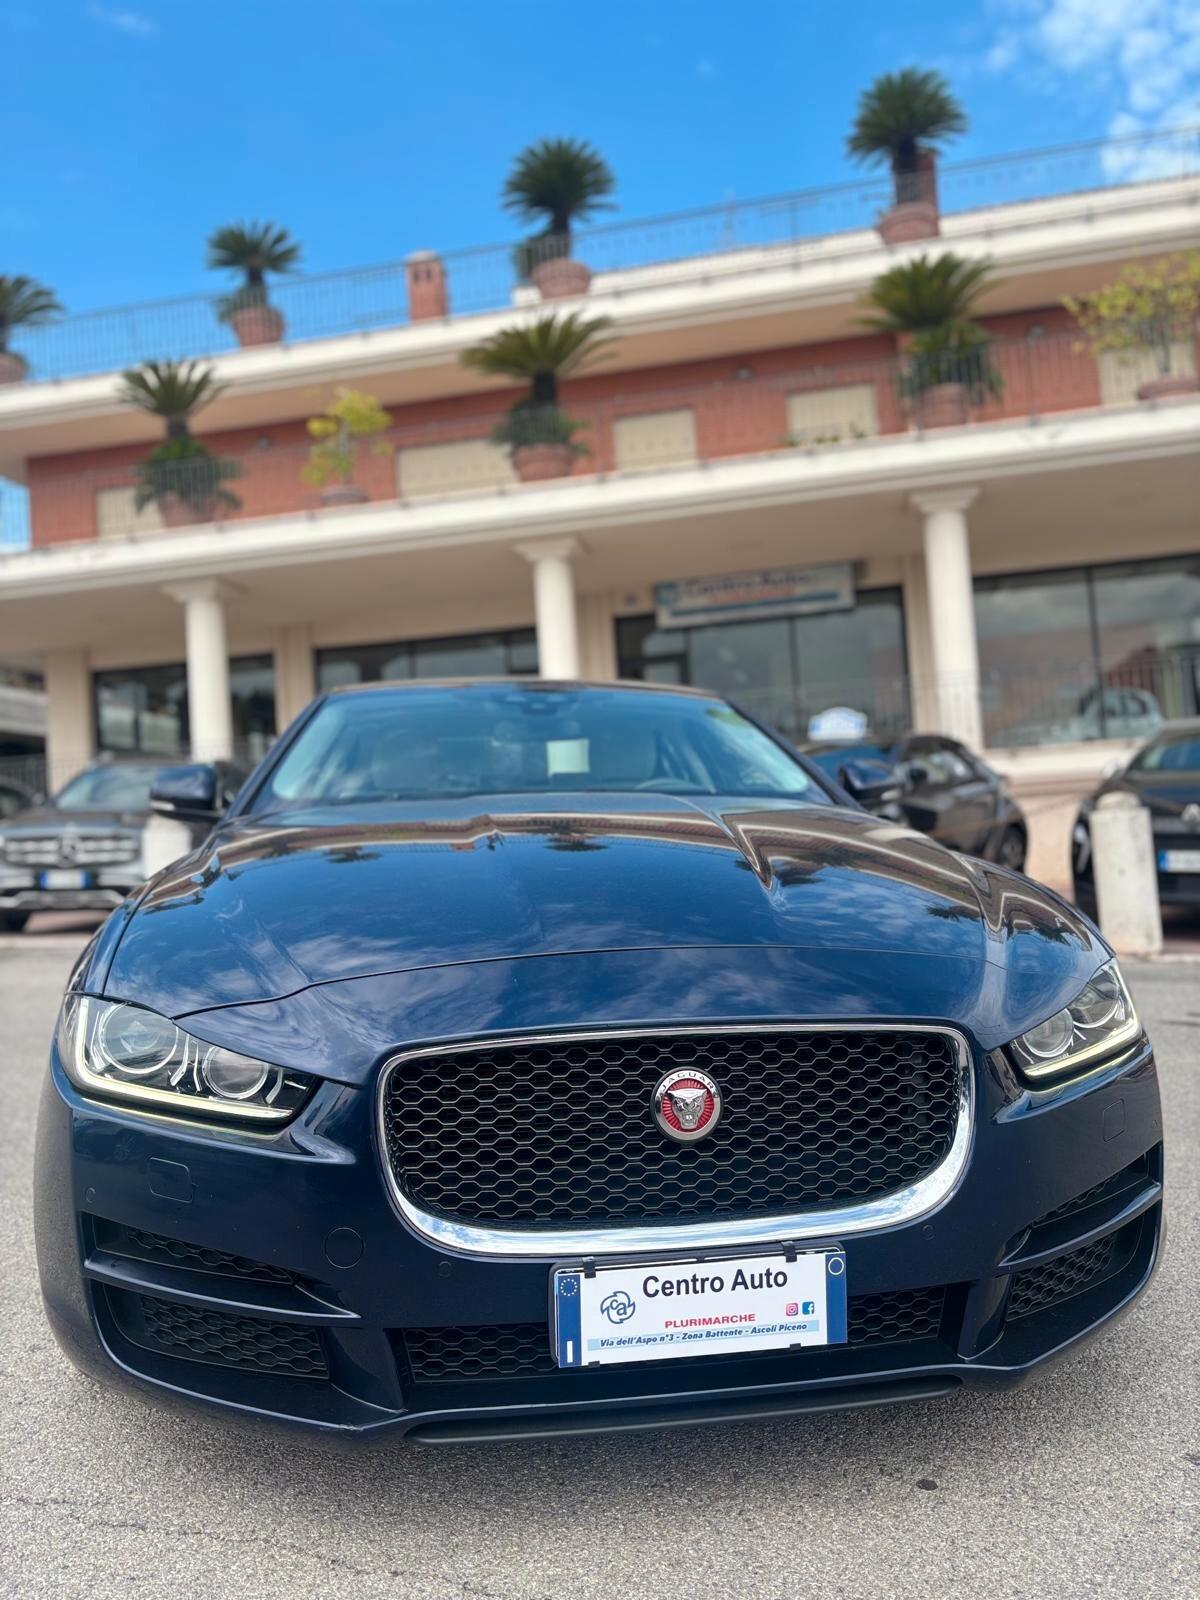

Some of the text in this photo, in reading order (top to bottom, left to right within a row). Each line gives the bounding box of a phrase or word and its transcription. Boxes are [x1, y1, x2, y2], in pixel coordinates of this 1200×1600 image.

[662, 1071, 715, 1092] JAGUAR
[642, 1268, 788, 1298] Centro Auto
[664, 1313, 756, 1329] PLURIMARCHE
[600, 1337, 614, 1347] Via
[682, 1332, 703, 1341] Zona
[705, 1329, 743, 1339] Battente
[751, 1324, 776, 1335] Ascoli
[778, 1323, 807, 1332] Piceno
